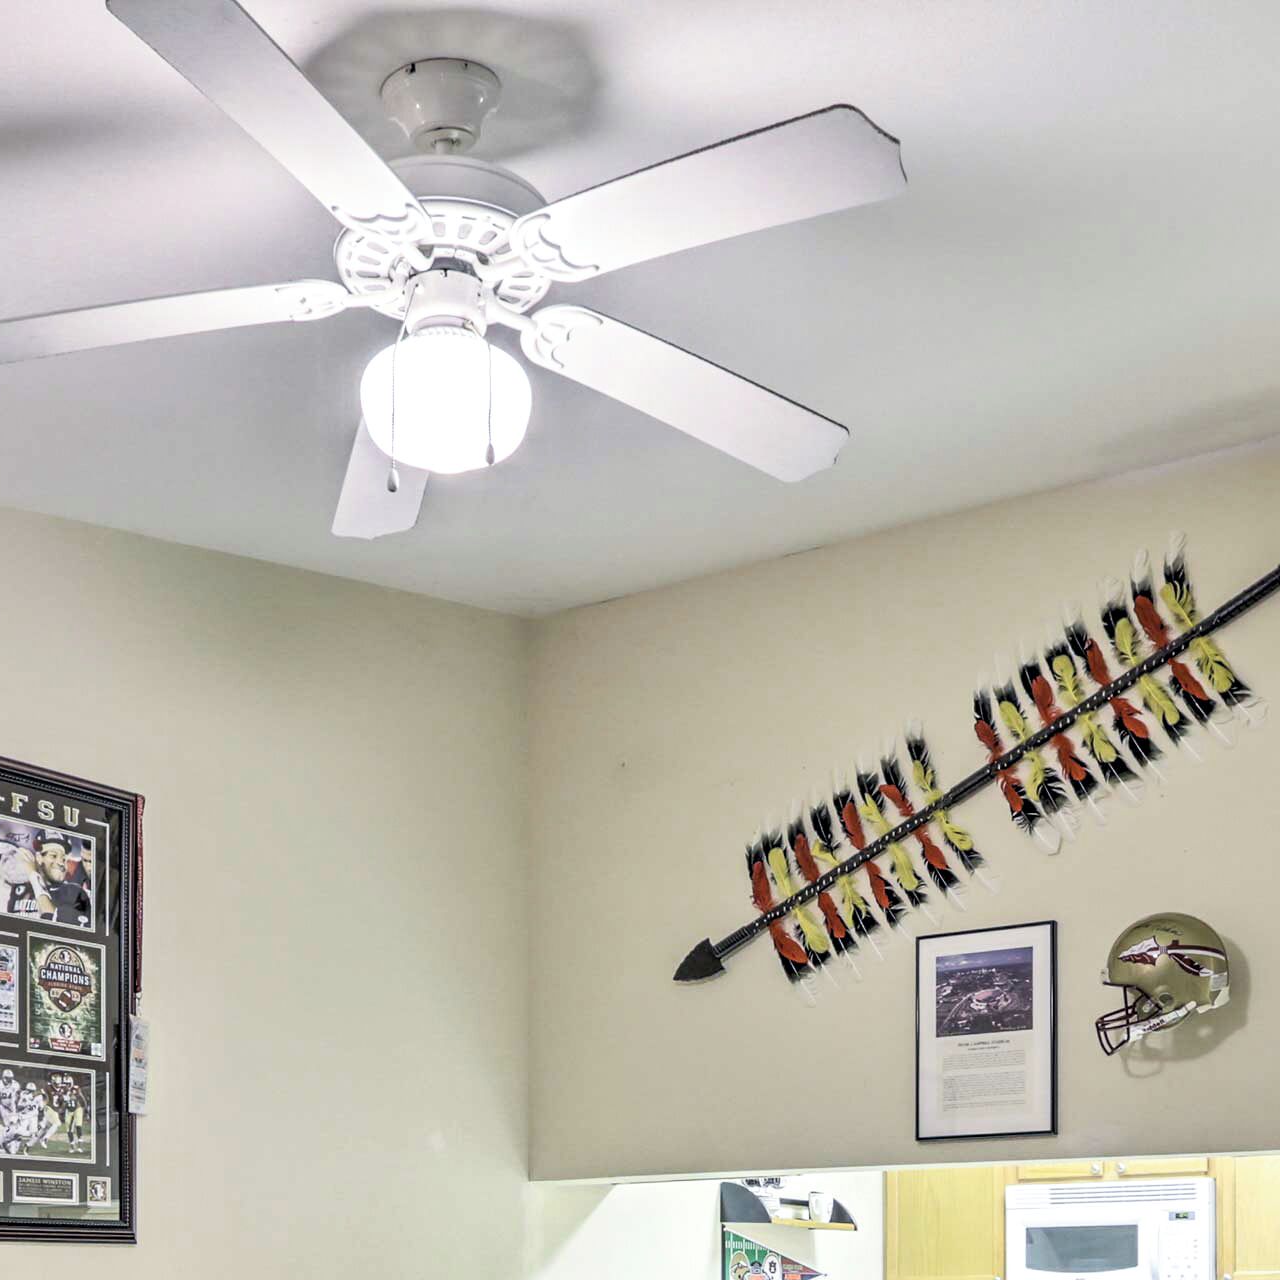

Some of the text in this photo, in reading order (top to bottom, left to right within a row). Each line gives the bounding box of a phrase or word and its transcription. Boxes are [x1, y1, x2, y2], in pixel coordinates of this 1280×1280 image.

[10, 792, 80, 828] FSU
[49, 962, 81, 973] NATIONAL
[40, 968, 90, 987] CHAMPIONS
